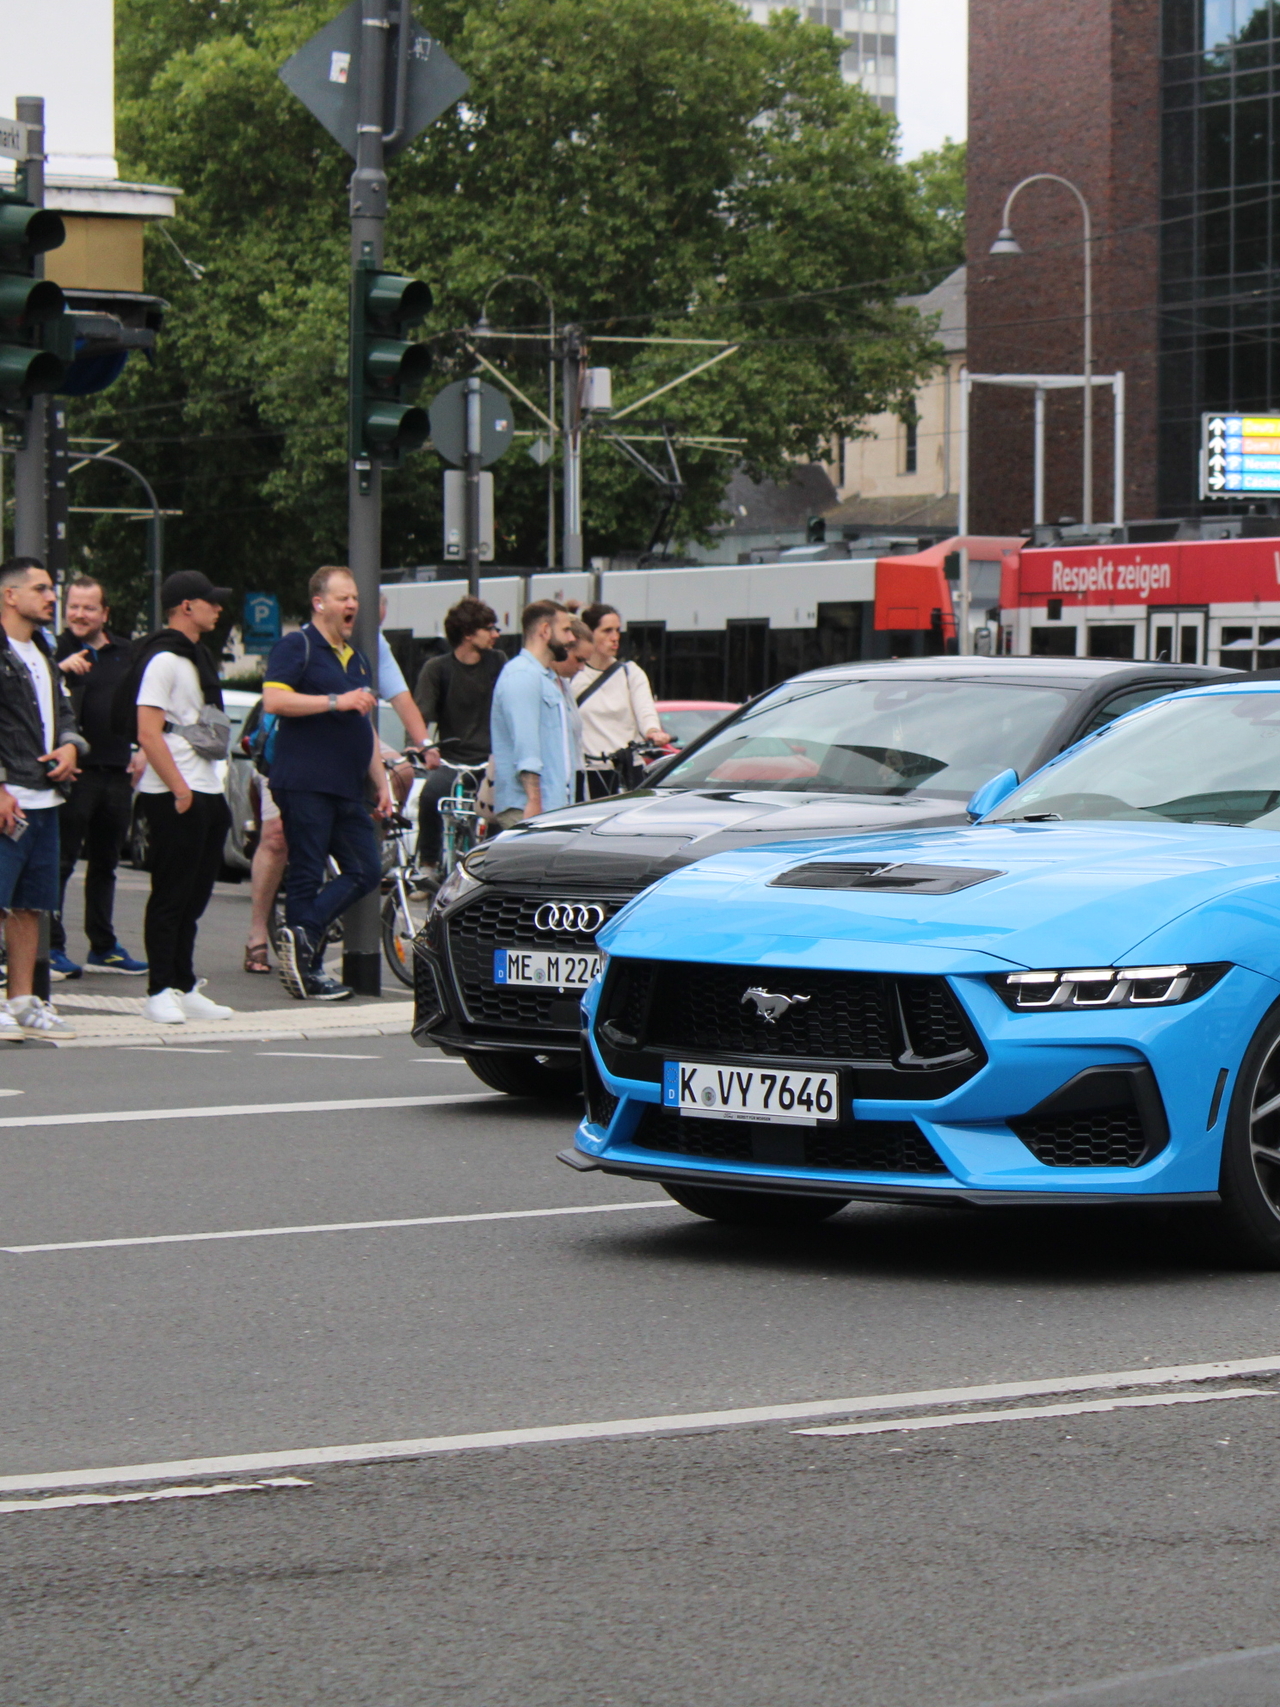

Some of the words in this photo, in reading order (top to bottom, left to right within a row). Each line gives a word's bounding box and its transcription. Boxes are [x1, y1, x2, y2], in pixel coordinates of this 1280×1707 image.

[1245, 440, 1270, 452] Dom
[1052, 556, 1114, 599] Respekt
[1117, 555, 1171, 598] zeigen
[508, 954, 533, 981] ME
[547, 956, 559, 982] M
[681, 1067, 698, 1103] K
[717, 1070, 753, 1107] VY
[760, 1073, 833, 1114] 7646
